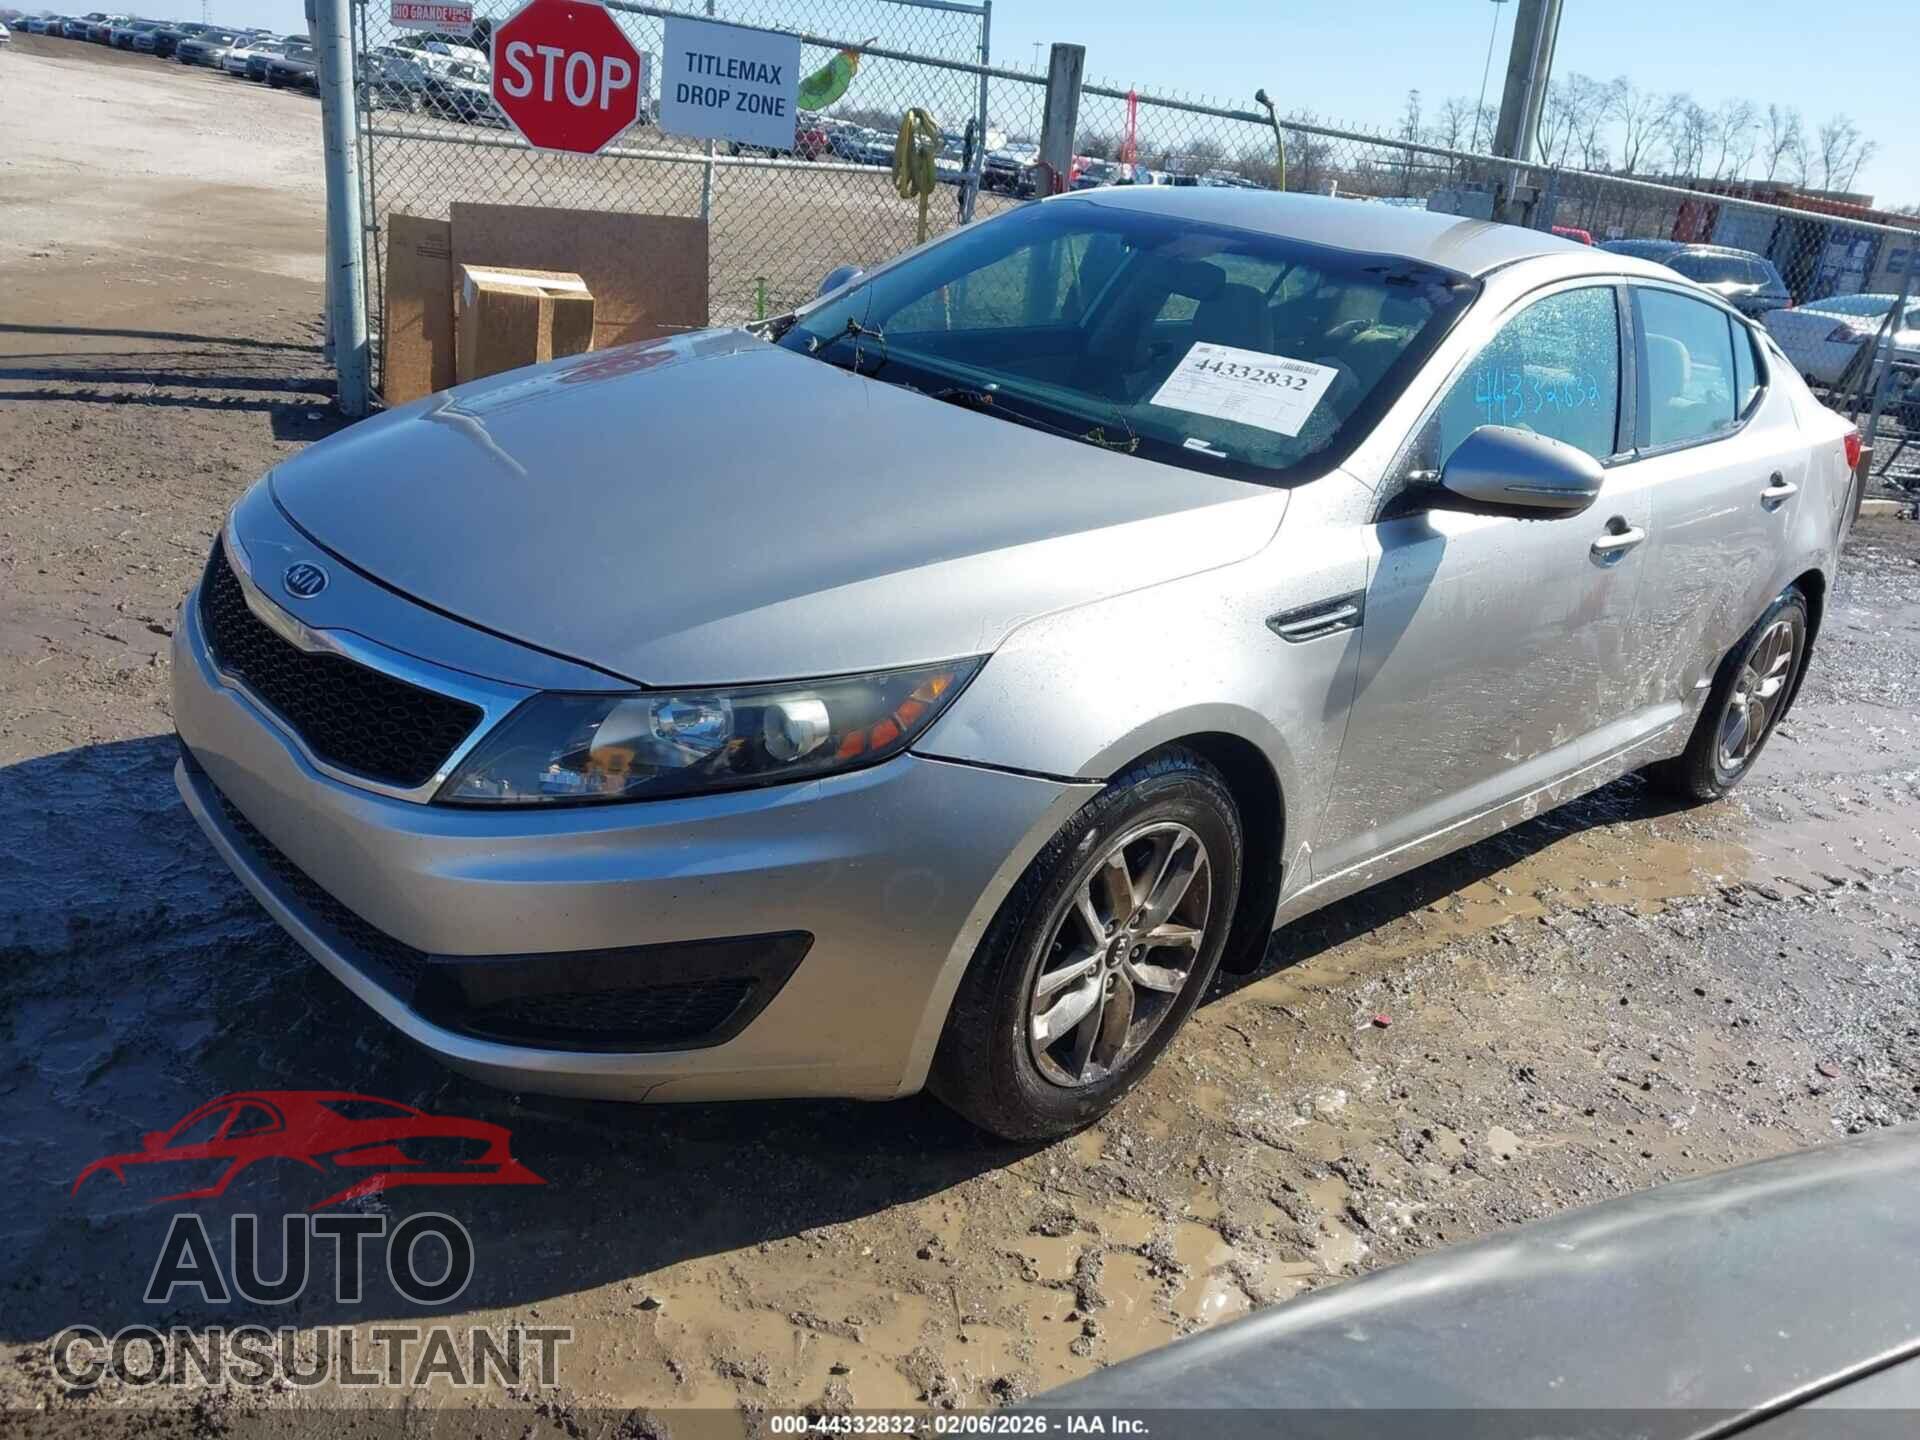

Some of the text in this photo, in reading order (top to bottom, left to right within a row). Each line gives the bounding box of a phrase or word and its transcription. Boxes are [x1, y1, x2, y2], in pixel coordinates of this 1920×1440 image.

[502, 42, 632, 110] STOP
[685, 51, 783, 86] TITLEMAX
[676, 84, 787, 118] DROP ZONE
[1194, 358, 1309, 391] 44332832
